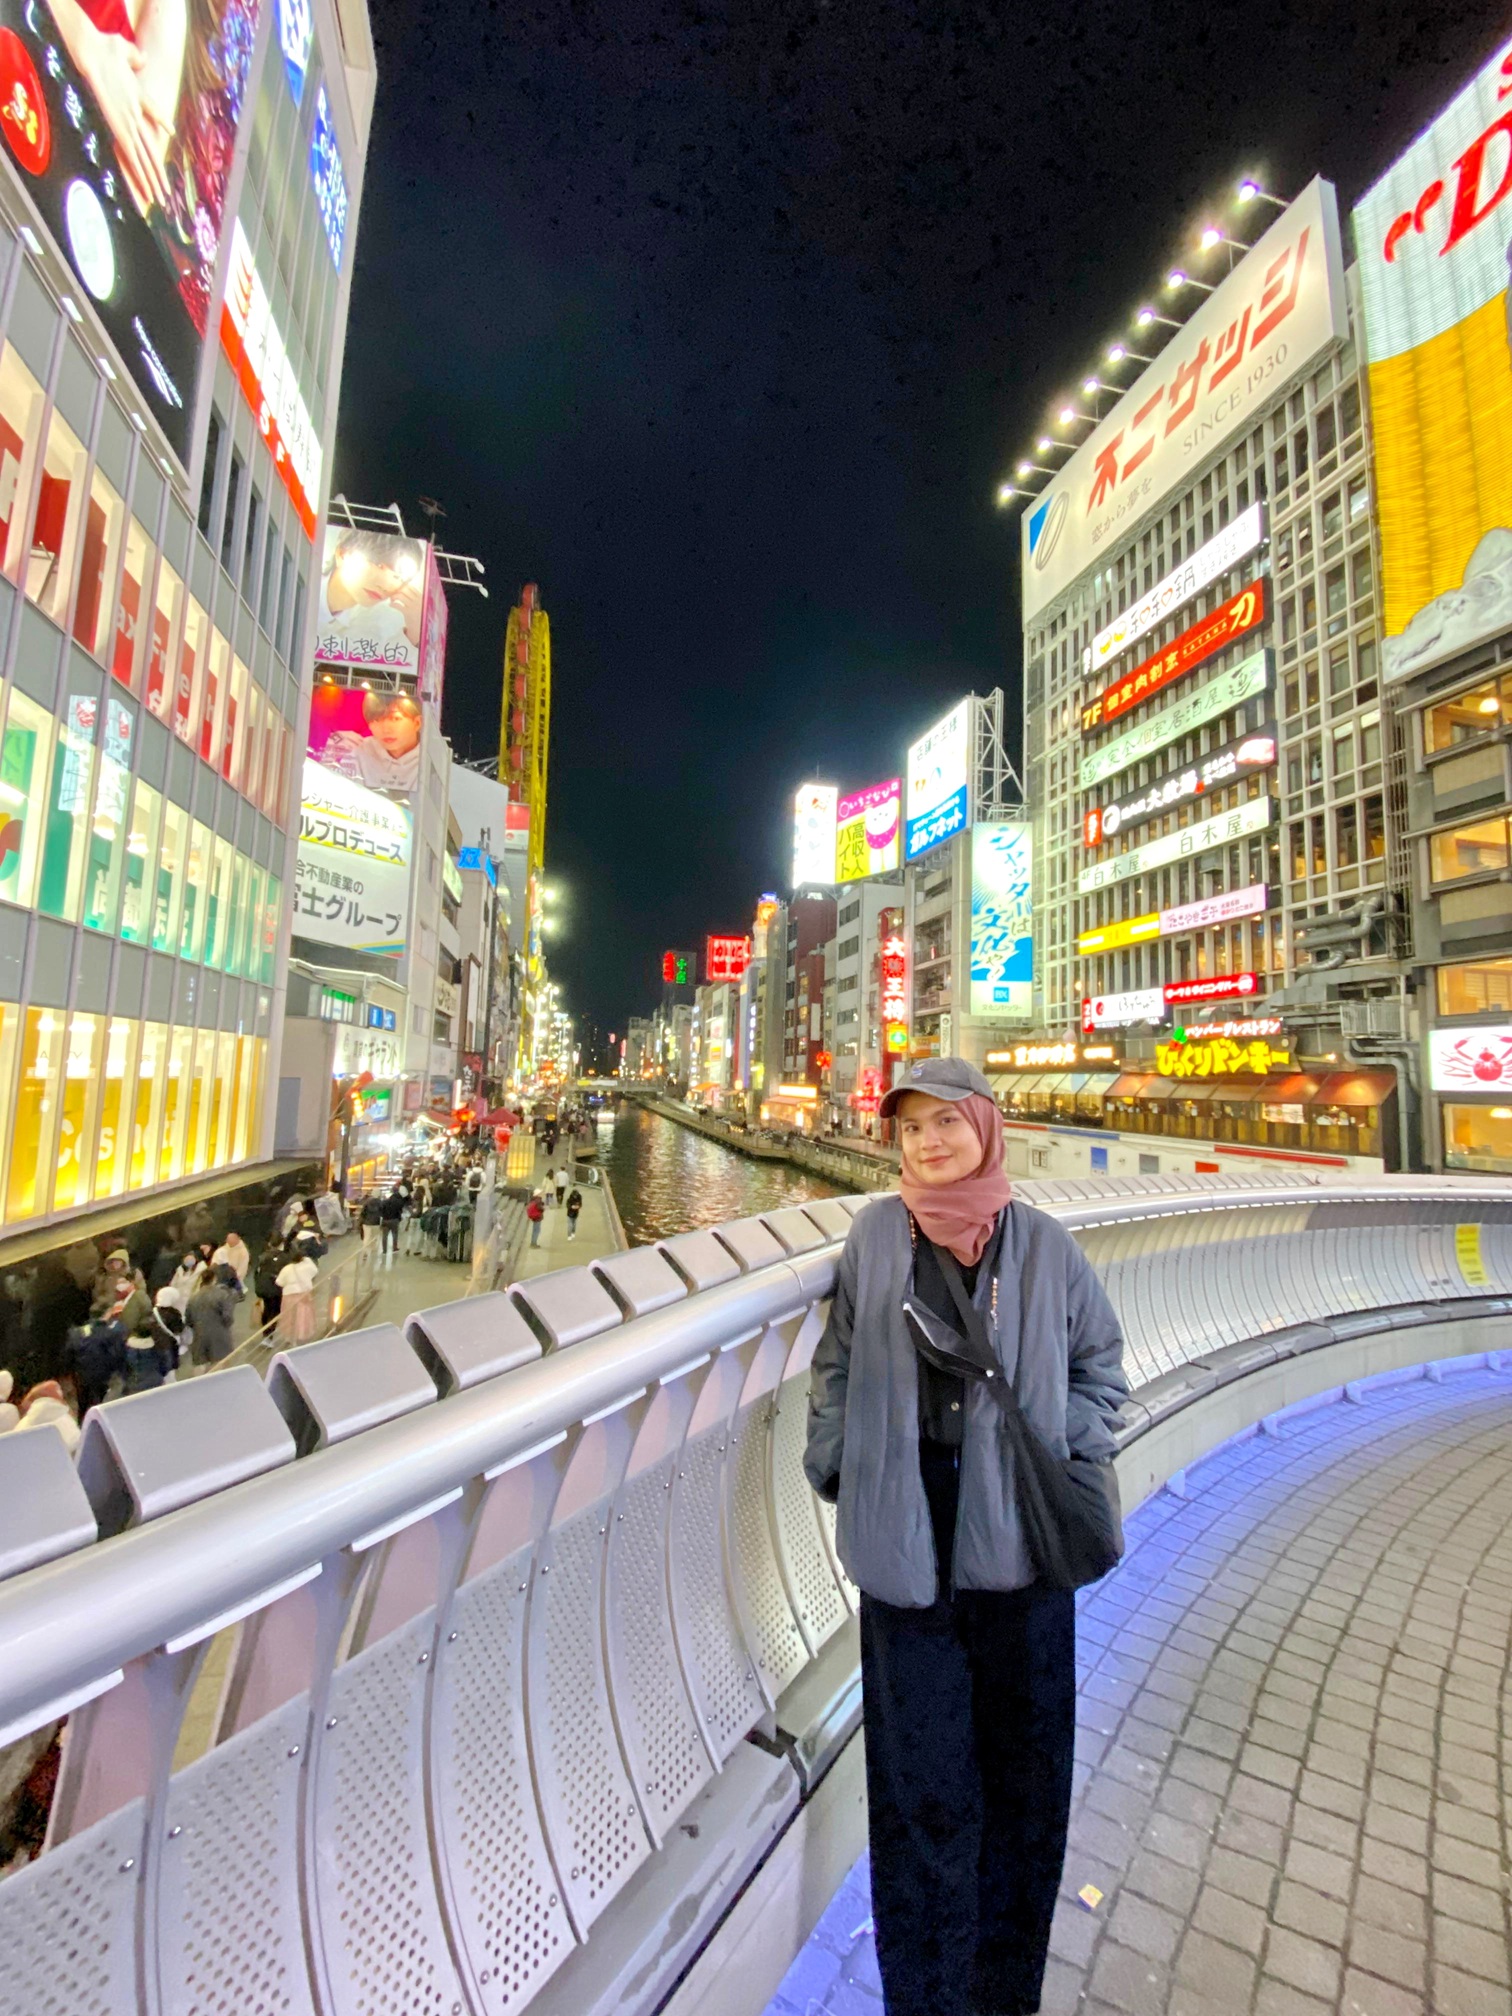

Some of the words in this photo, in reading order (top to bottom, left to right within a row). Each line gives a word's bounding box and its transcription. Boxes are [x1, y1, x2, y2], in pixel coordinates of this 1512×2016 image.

[1182, 387, 1243, 456] SINCE
[1246, 343, 1288, 395] 1930
[1229, 591, 1255, 634] 刀
[316, 634, 408, 664] 刺激的
[1083, 701, 1102, 730] 7F
[839, 825, 852, 880] バイト
[1180, 813, 1243, 854] 白木屋
[1094, 854, 1140, 886] 白木屋
[1185, 1019, 1281, 1037] ハンバーグレストラン
[1154, 1037, 1290, 1077] びっくりドンキー
